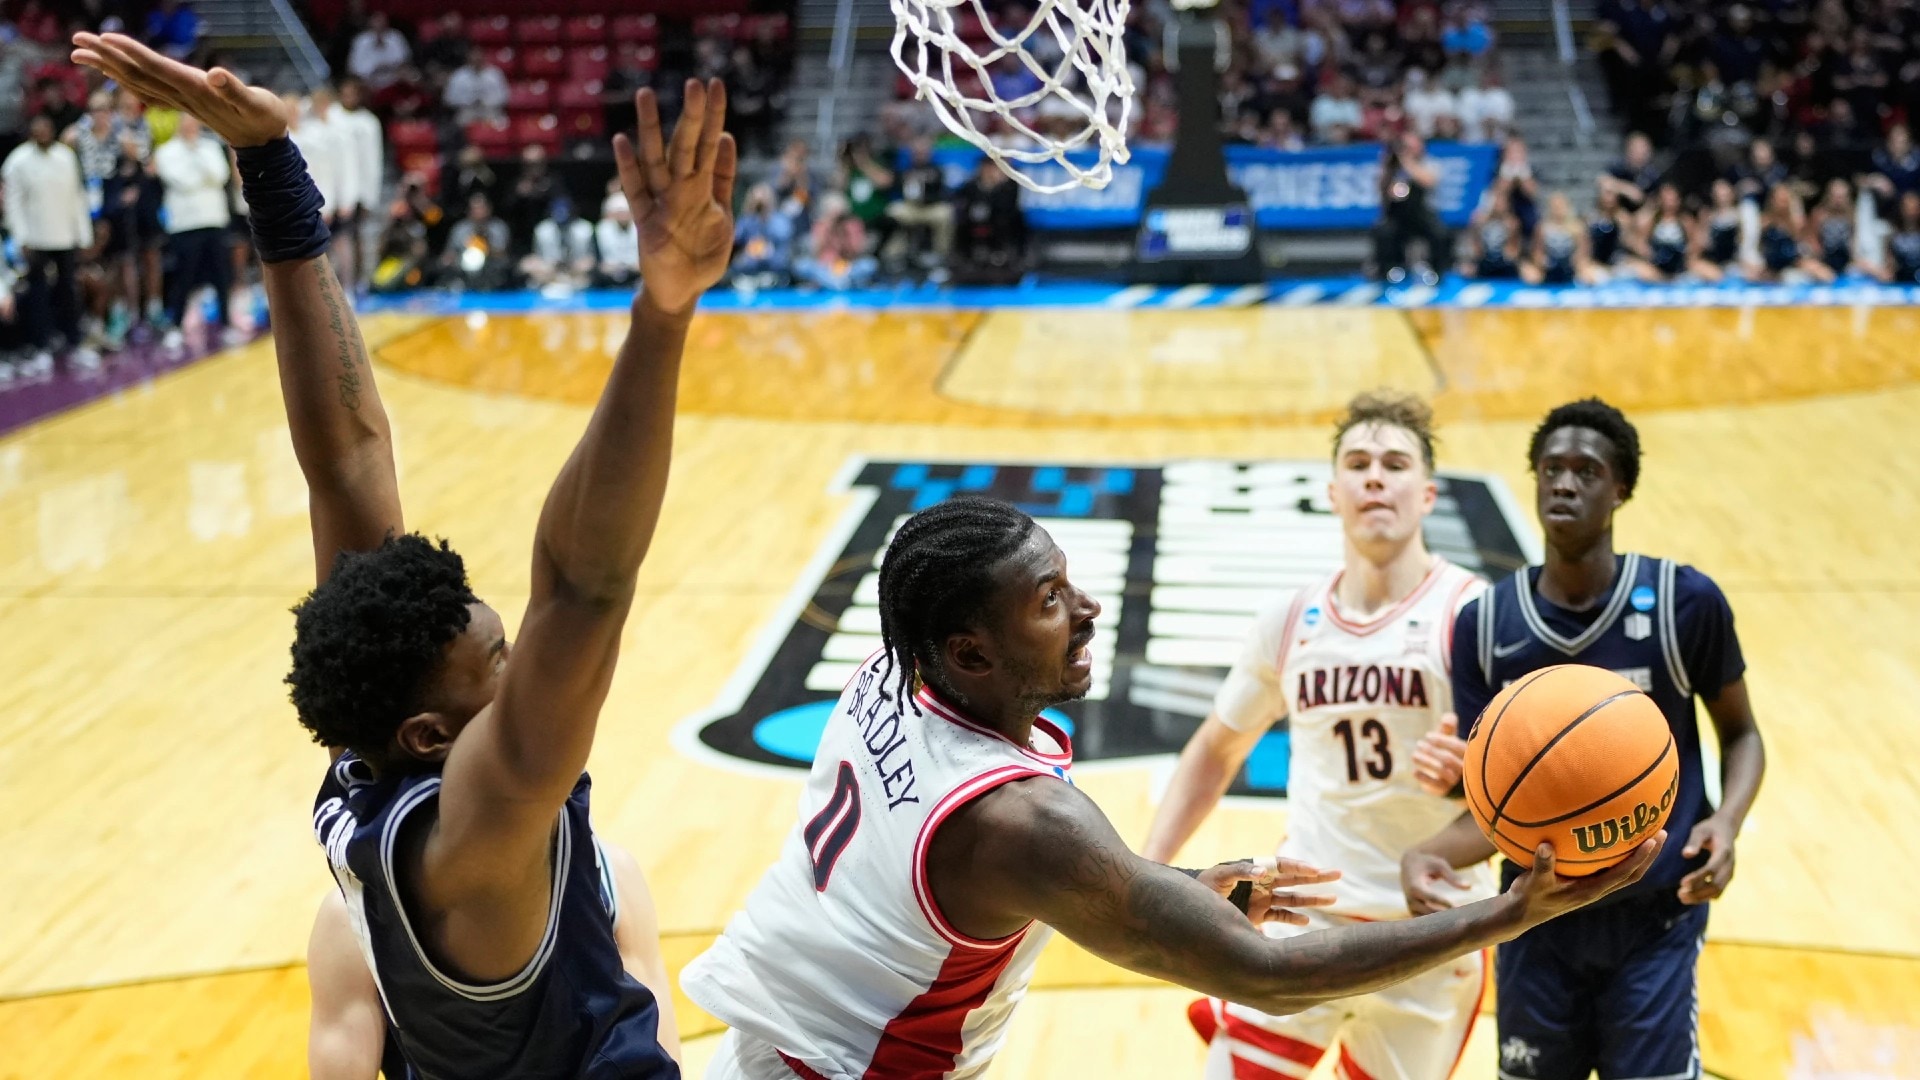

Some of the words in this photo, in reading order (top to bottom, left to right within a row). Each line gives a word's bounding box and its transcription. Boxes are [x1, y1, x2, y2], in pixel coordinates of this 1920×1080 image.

[1297, 665, 1429, 711] ARIZONA
[847, 671, 919, 812] BRADLEY
[1333, 719, 1392, 783] 13
[804, 760, 861, 892] 0
[1571, 770, 1679, 854] Wilson
